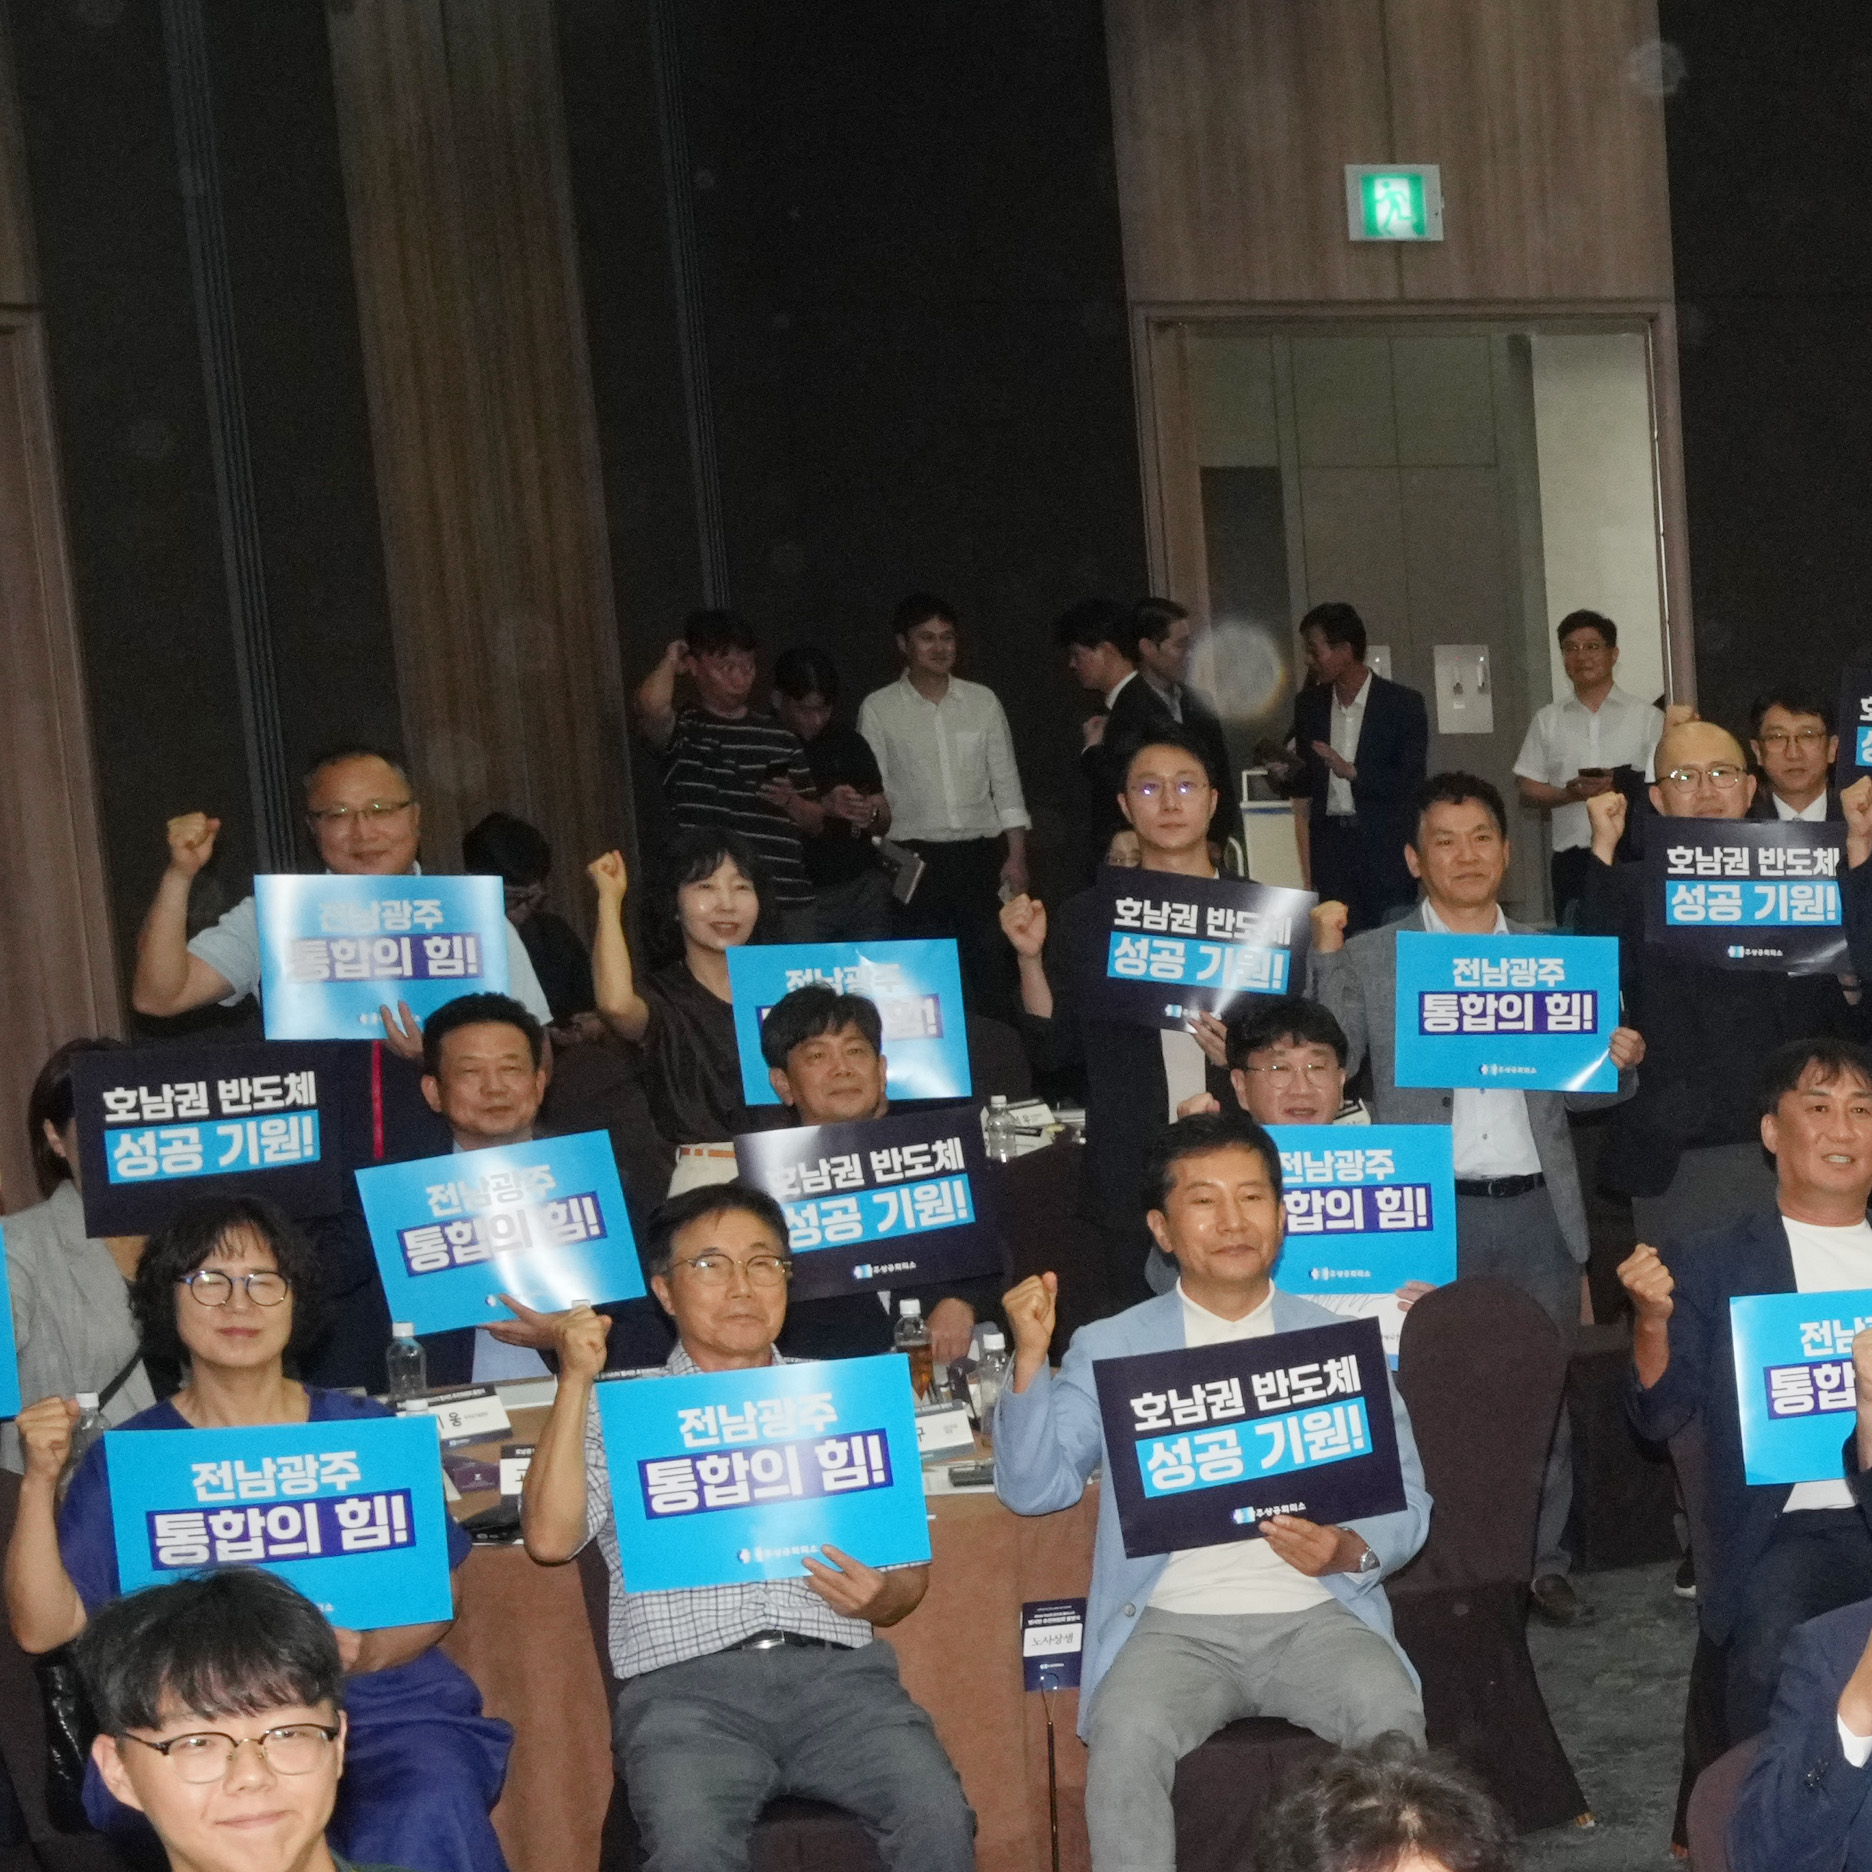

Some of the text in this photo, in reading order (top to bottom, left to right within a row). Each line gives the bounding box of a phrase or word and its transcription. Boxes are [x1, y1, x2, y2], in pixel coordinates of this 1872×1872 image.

[1666, 847, 1840, 877] 호남권 반도체
[1113, 897, 1199, 935] 호남권
[1671, 884, 1837, 922] 성공 기원!
[423, 934, 481, 976] 힘!
[1114, 936, 1284, 989] 성공 기원!
[1453, 959, 1565, 988] 전남광주
[1422, 992, 1593, 1032] 통합의 힘!
[103, 1071, 317, 1121] 호남권 반도체
[113, 1114, 314, 1178] 성공 기원!
[876, 1143, 965, 1183] 반도체
[427, 1164, 557, 1217] 전남광주
[785, 1179, 968, 1249] 성공 기원!
[1374, 1186, 1428, 1229] 힘!
[405, 1197, 602, 1277] 통합의 힘!
[1130, 1354, 1362, 1432] 호남권 반도체
[679, 1392, 838, 1448] 전남광주
[1147, 1404, 1365, 1490] 성공 기원!
[191, 1452, 361, 1502] 전남광주
[646, 1434, 886, 1513] 통합의 힘!
[154, 1494, 408, 1565] 통합의 힘!
